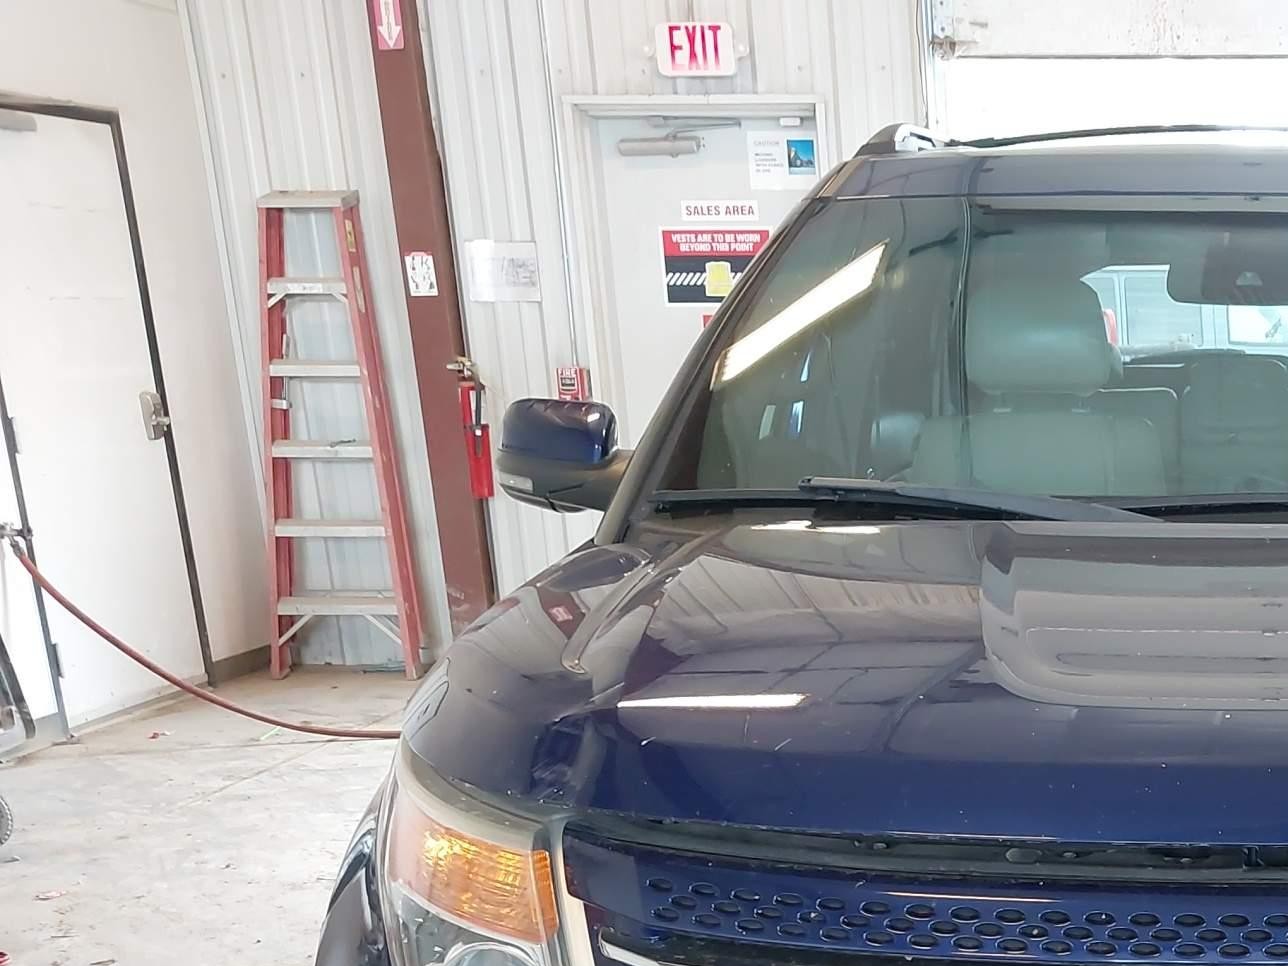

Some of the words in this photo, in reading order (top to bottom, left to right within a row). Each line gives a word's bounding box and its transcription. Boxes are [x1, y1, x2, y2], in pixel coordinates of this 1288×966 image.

[668, 25, 722, 71] EXIT
[685, 205, 721, 216] SALES
[725, 205, 755, 216] AREA
[672, 233, 696, 243] VESTS
[697, 233, 712, 243] ARE
[713, 233, 723, 243] TO
[725, 233, 735, 243] BE
[736, 233, 760, 243] WORN
[680, 243, 711, 252] BEYOND
[712, 243, 730, 252] THIS
[731, 243, 754, 252] POINT
